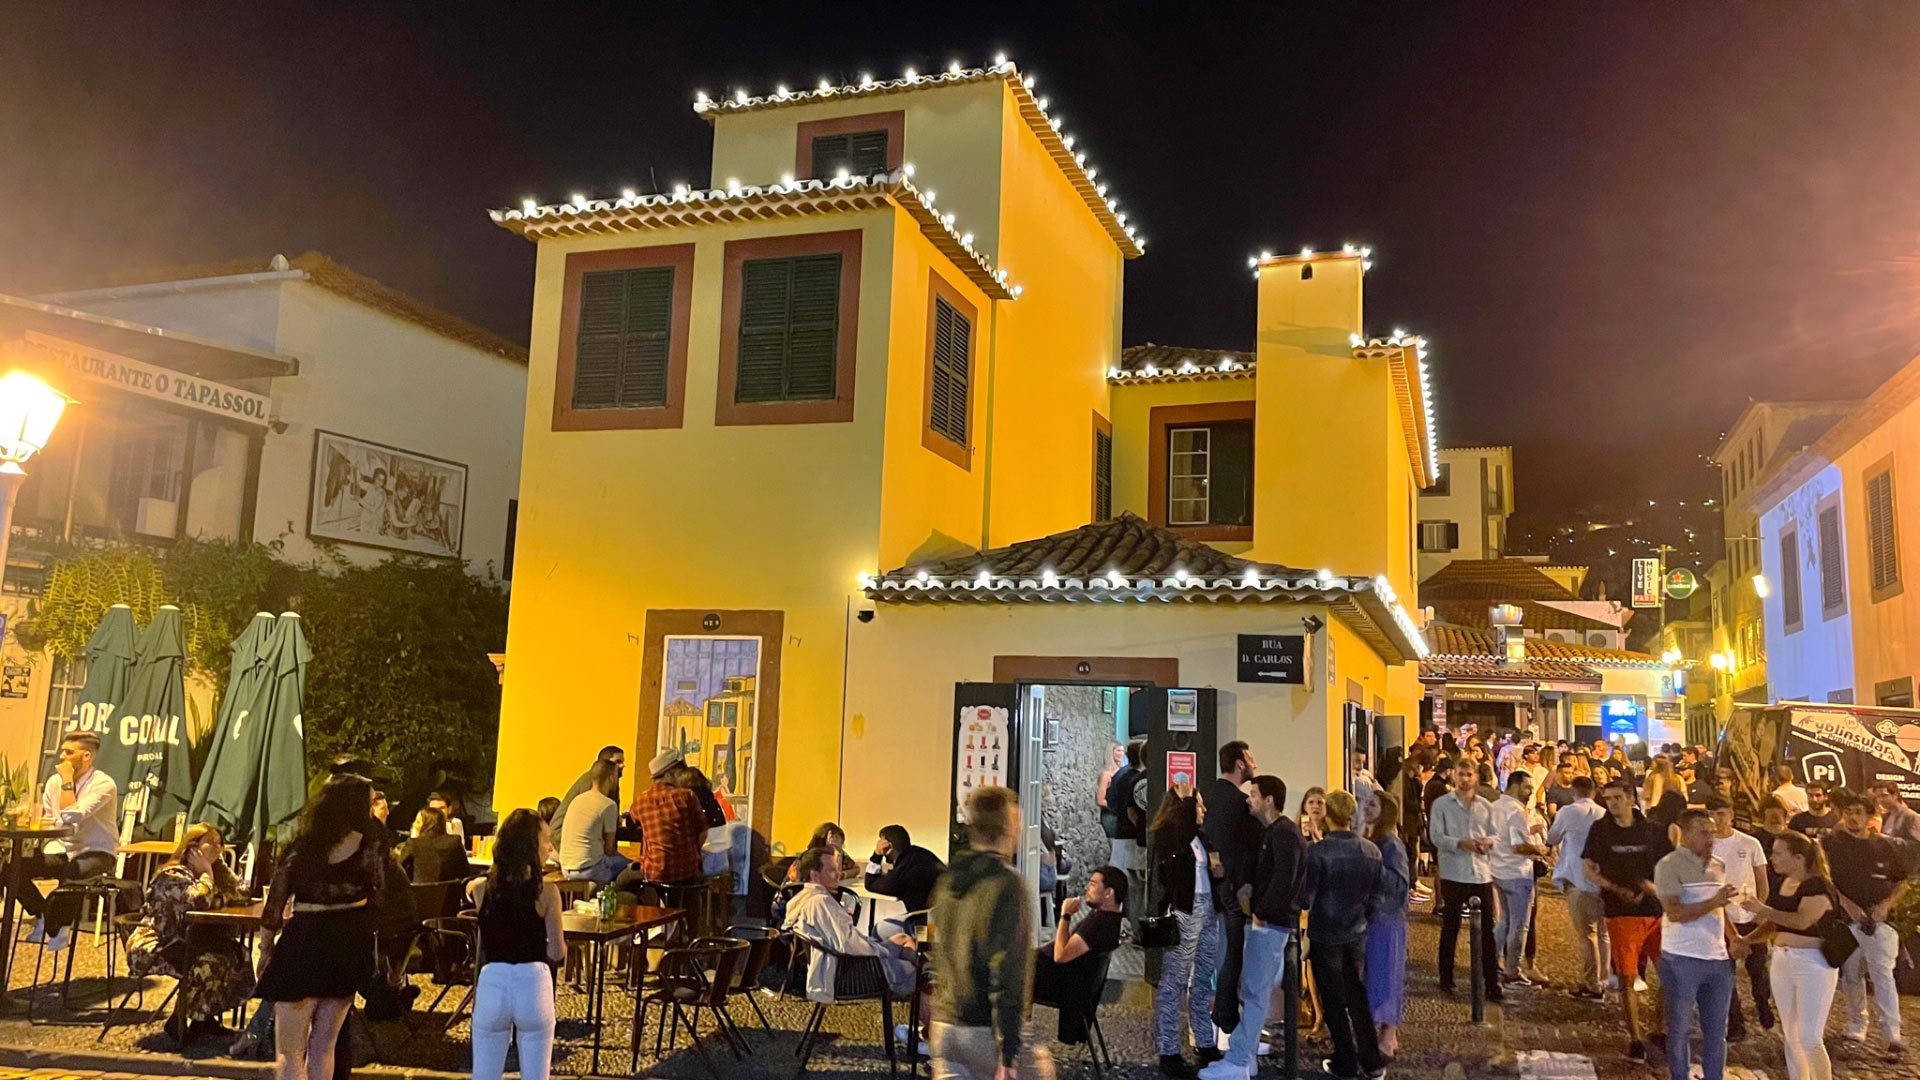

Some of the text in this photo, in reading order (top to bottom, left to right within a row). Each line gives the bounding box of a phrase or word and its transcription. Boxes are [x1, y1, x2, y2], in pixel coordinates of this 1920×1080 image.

[155, 374, 169, 394] O
[174, 378, 266, 420] TAPASSOL
[1262, 640, 1283, 650] RUA
[1254, 655, 1293, 664] CARLOS
[1813, 764, 1835, 782] Pi
[1875, 773, 1905, 781] DESIGN
